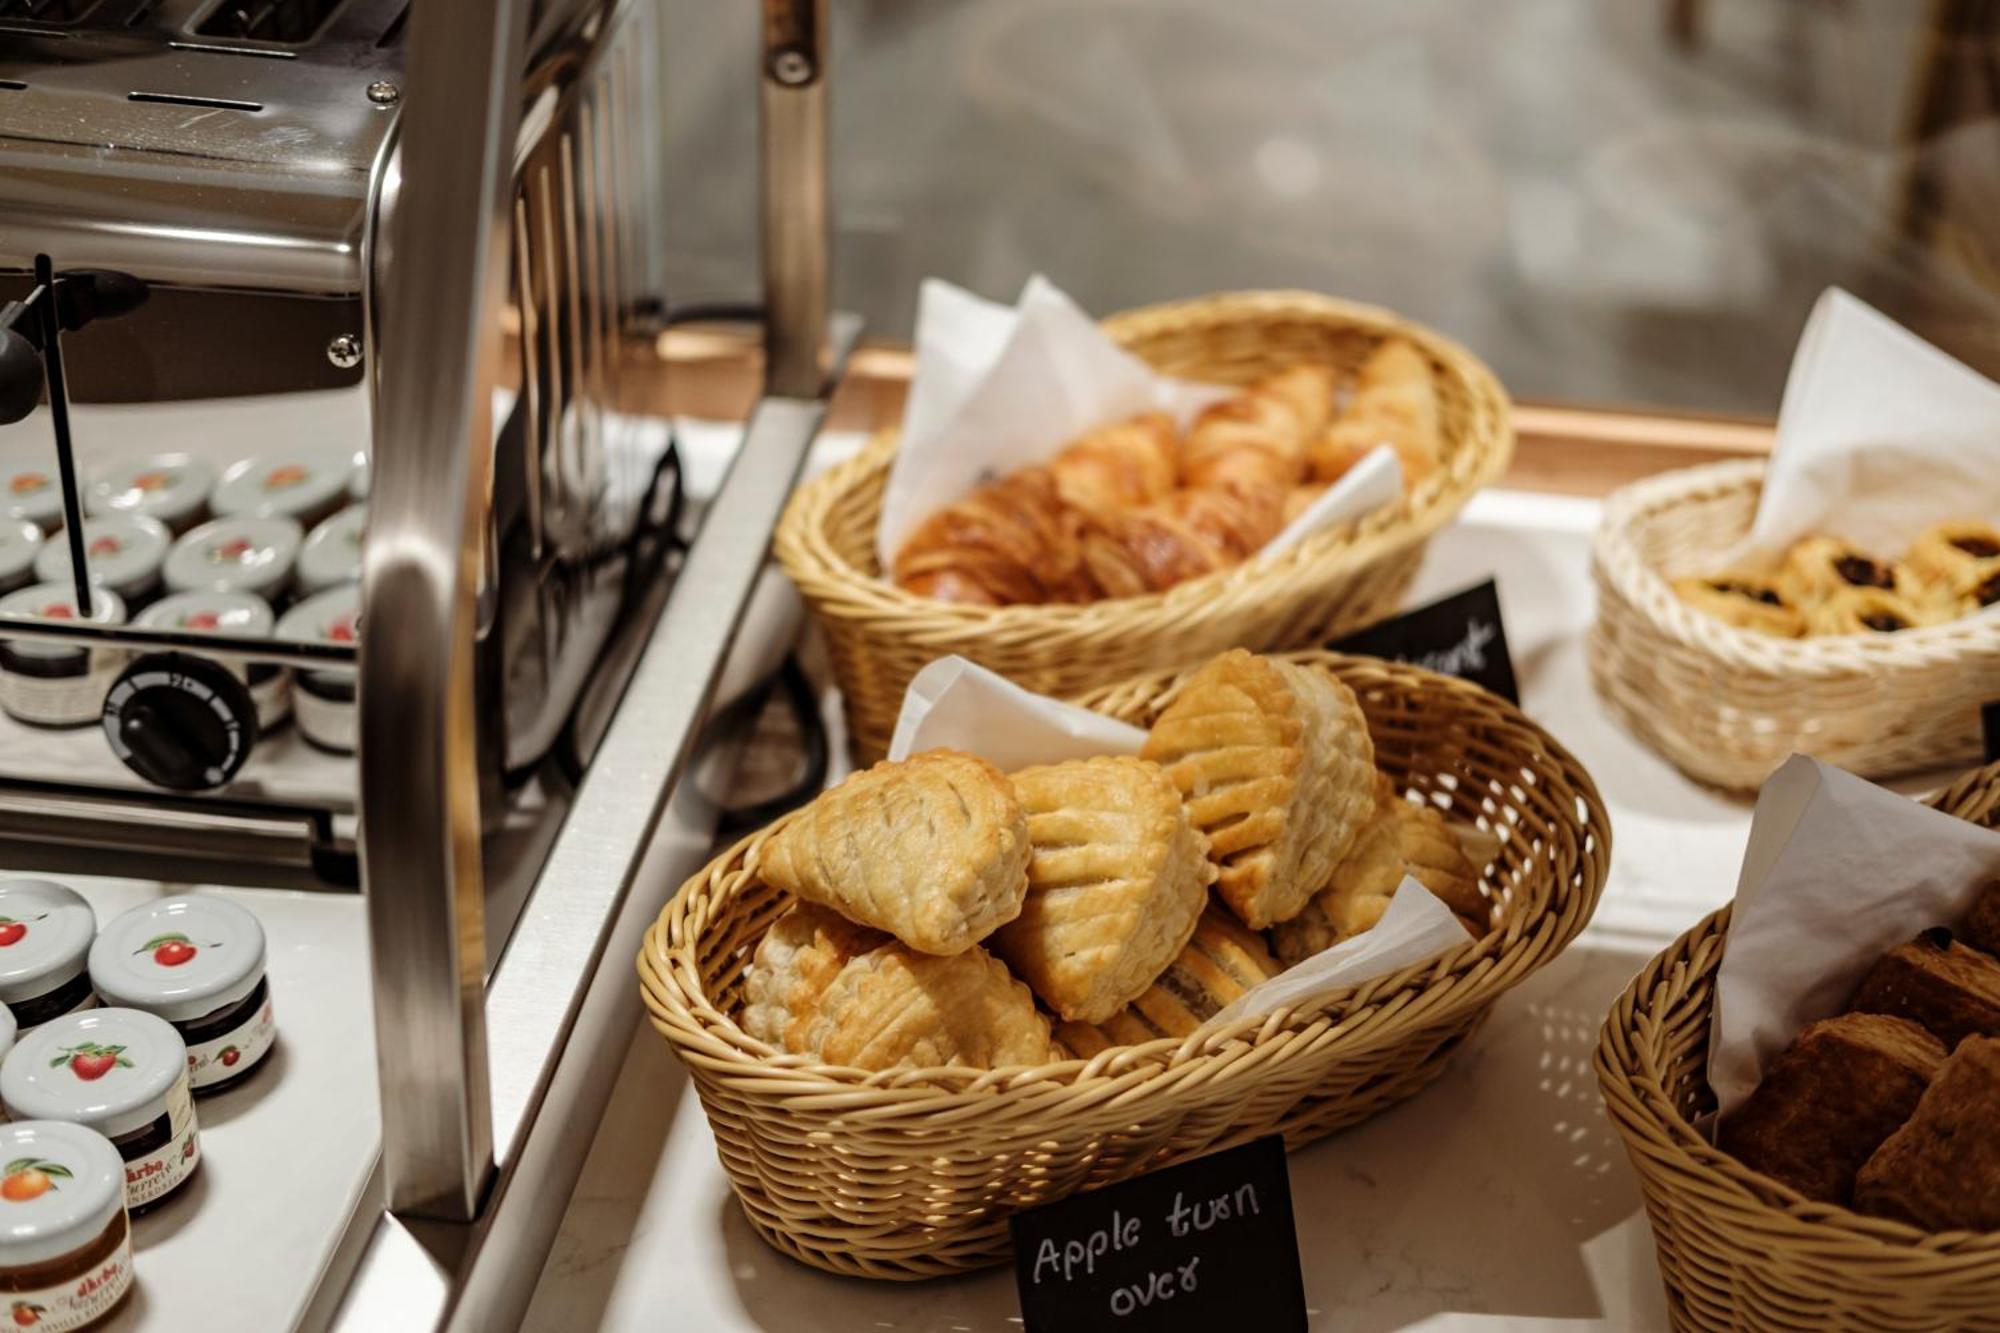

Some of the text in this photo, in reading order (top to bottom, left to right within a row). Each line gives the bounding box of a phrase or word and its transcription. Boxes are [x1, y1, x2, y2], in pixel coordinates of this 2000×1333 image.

[1033, 1183, 1260, 1284] Apple turn
[1110, 1256, 1200, 1317] over
